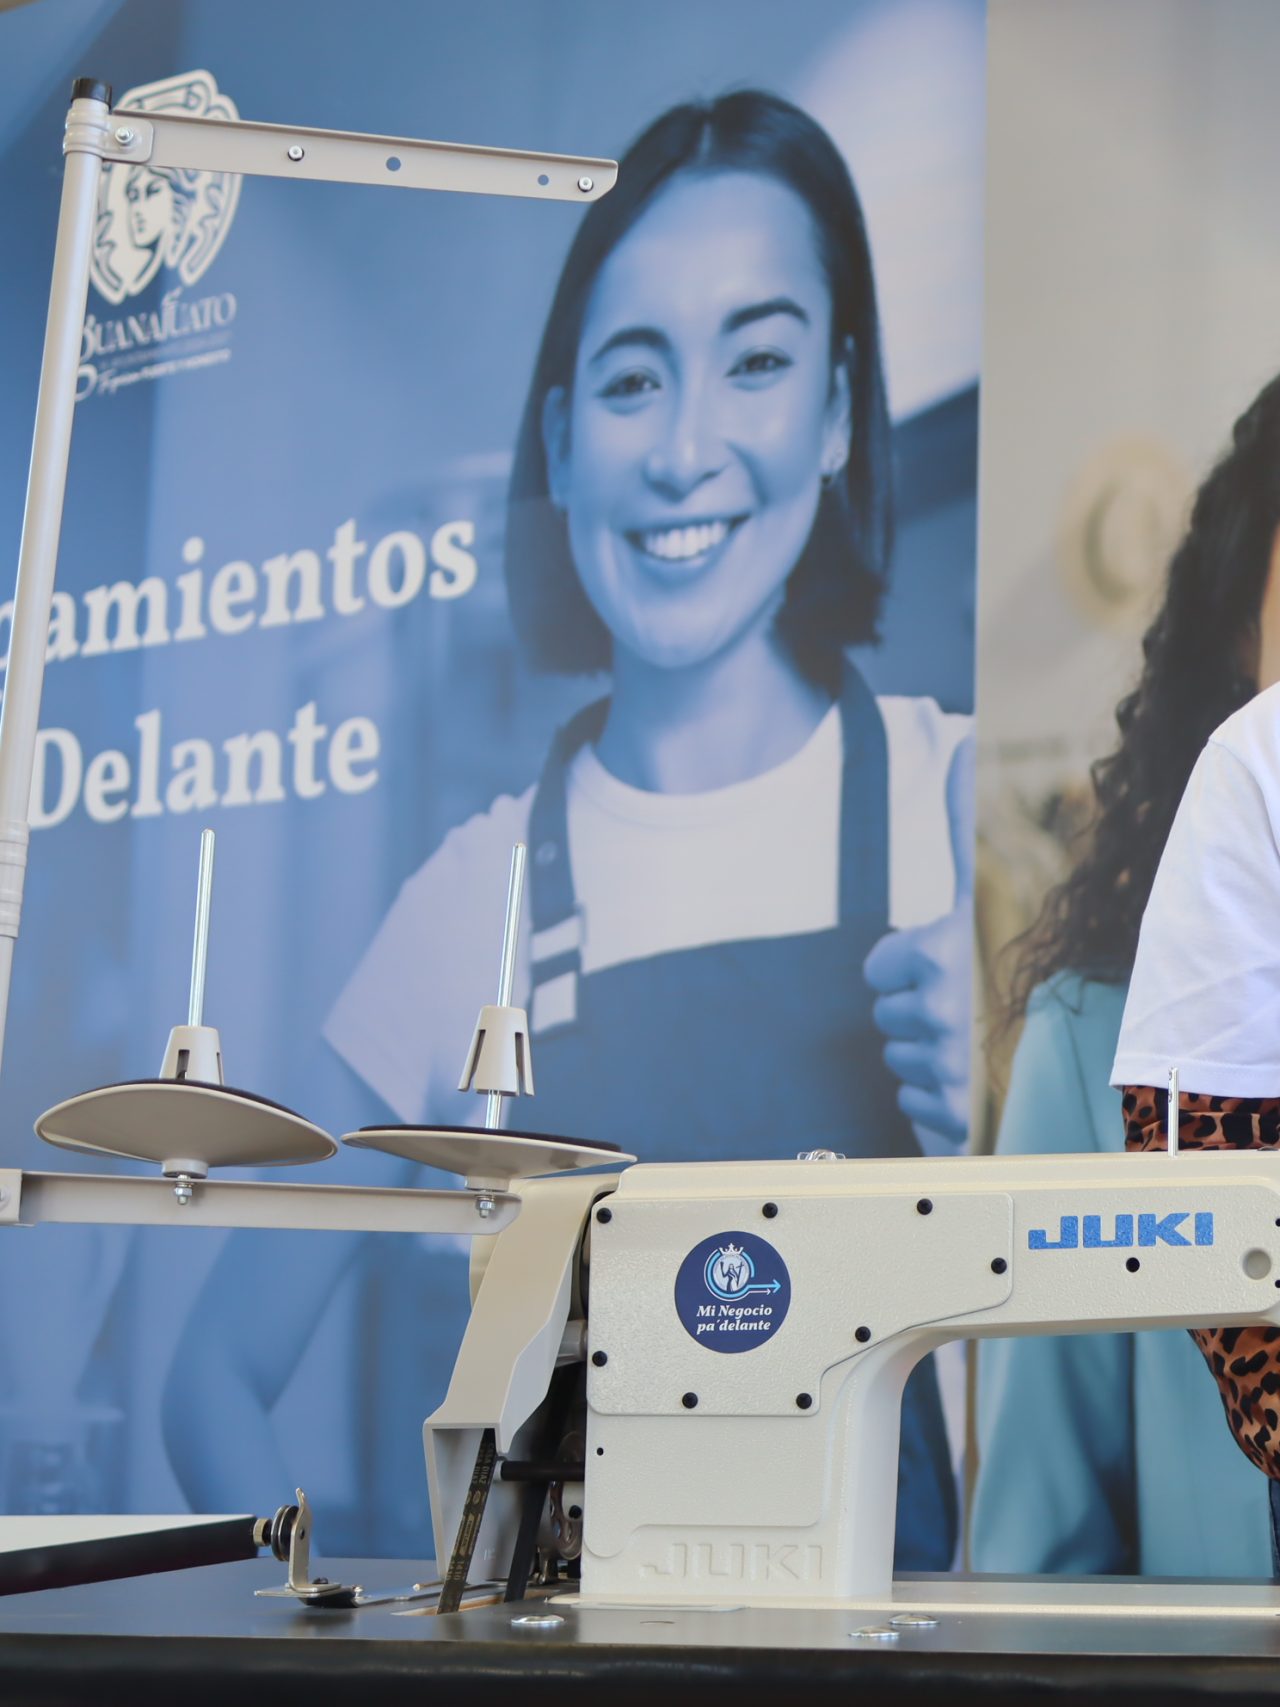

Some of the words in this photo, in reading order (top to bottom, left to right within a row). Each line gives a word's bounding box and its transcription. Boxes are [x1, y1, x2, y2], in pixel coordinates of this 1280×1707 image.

[27, 700, 380, 829] Delante
[1028, 1212, 1213, 1250] JUKI
[696, 1305, 716, 1317] Mi
[718, 1304, 773, 1320] Negocio
[638, 1543, 823, 1580] JUKI
